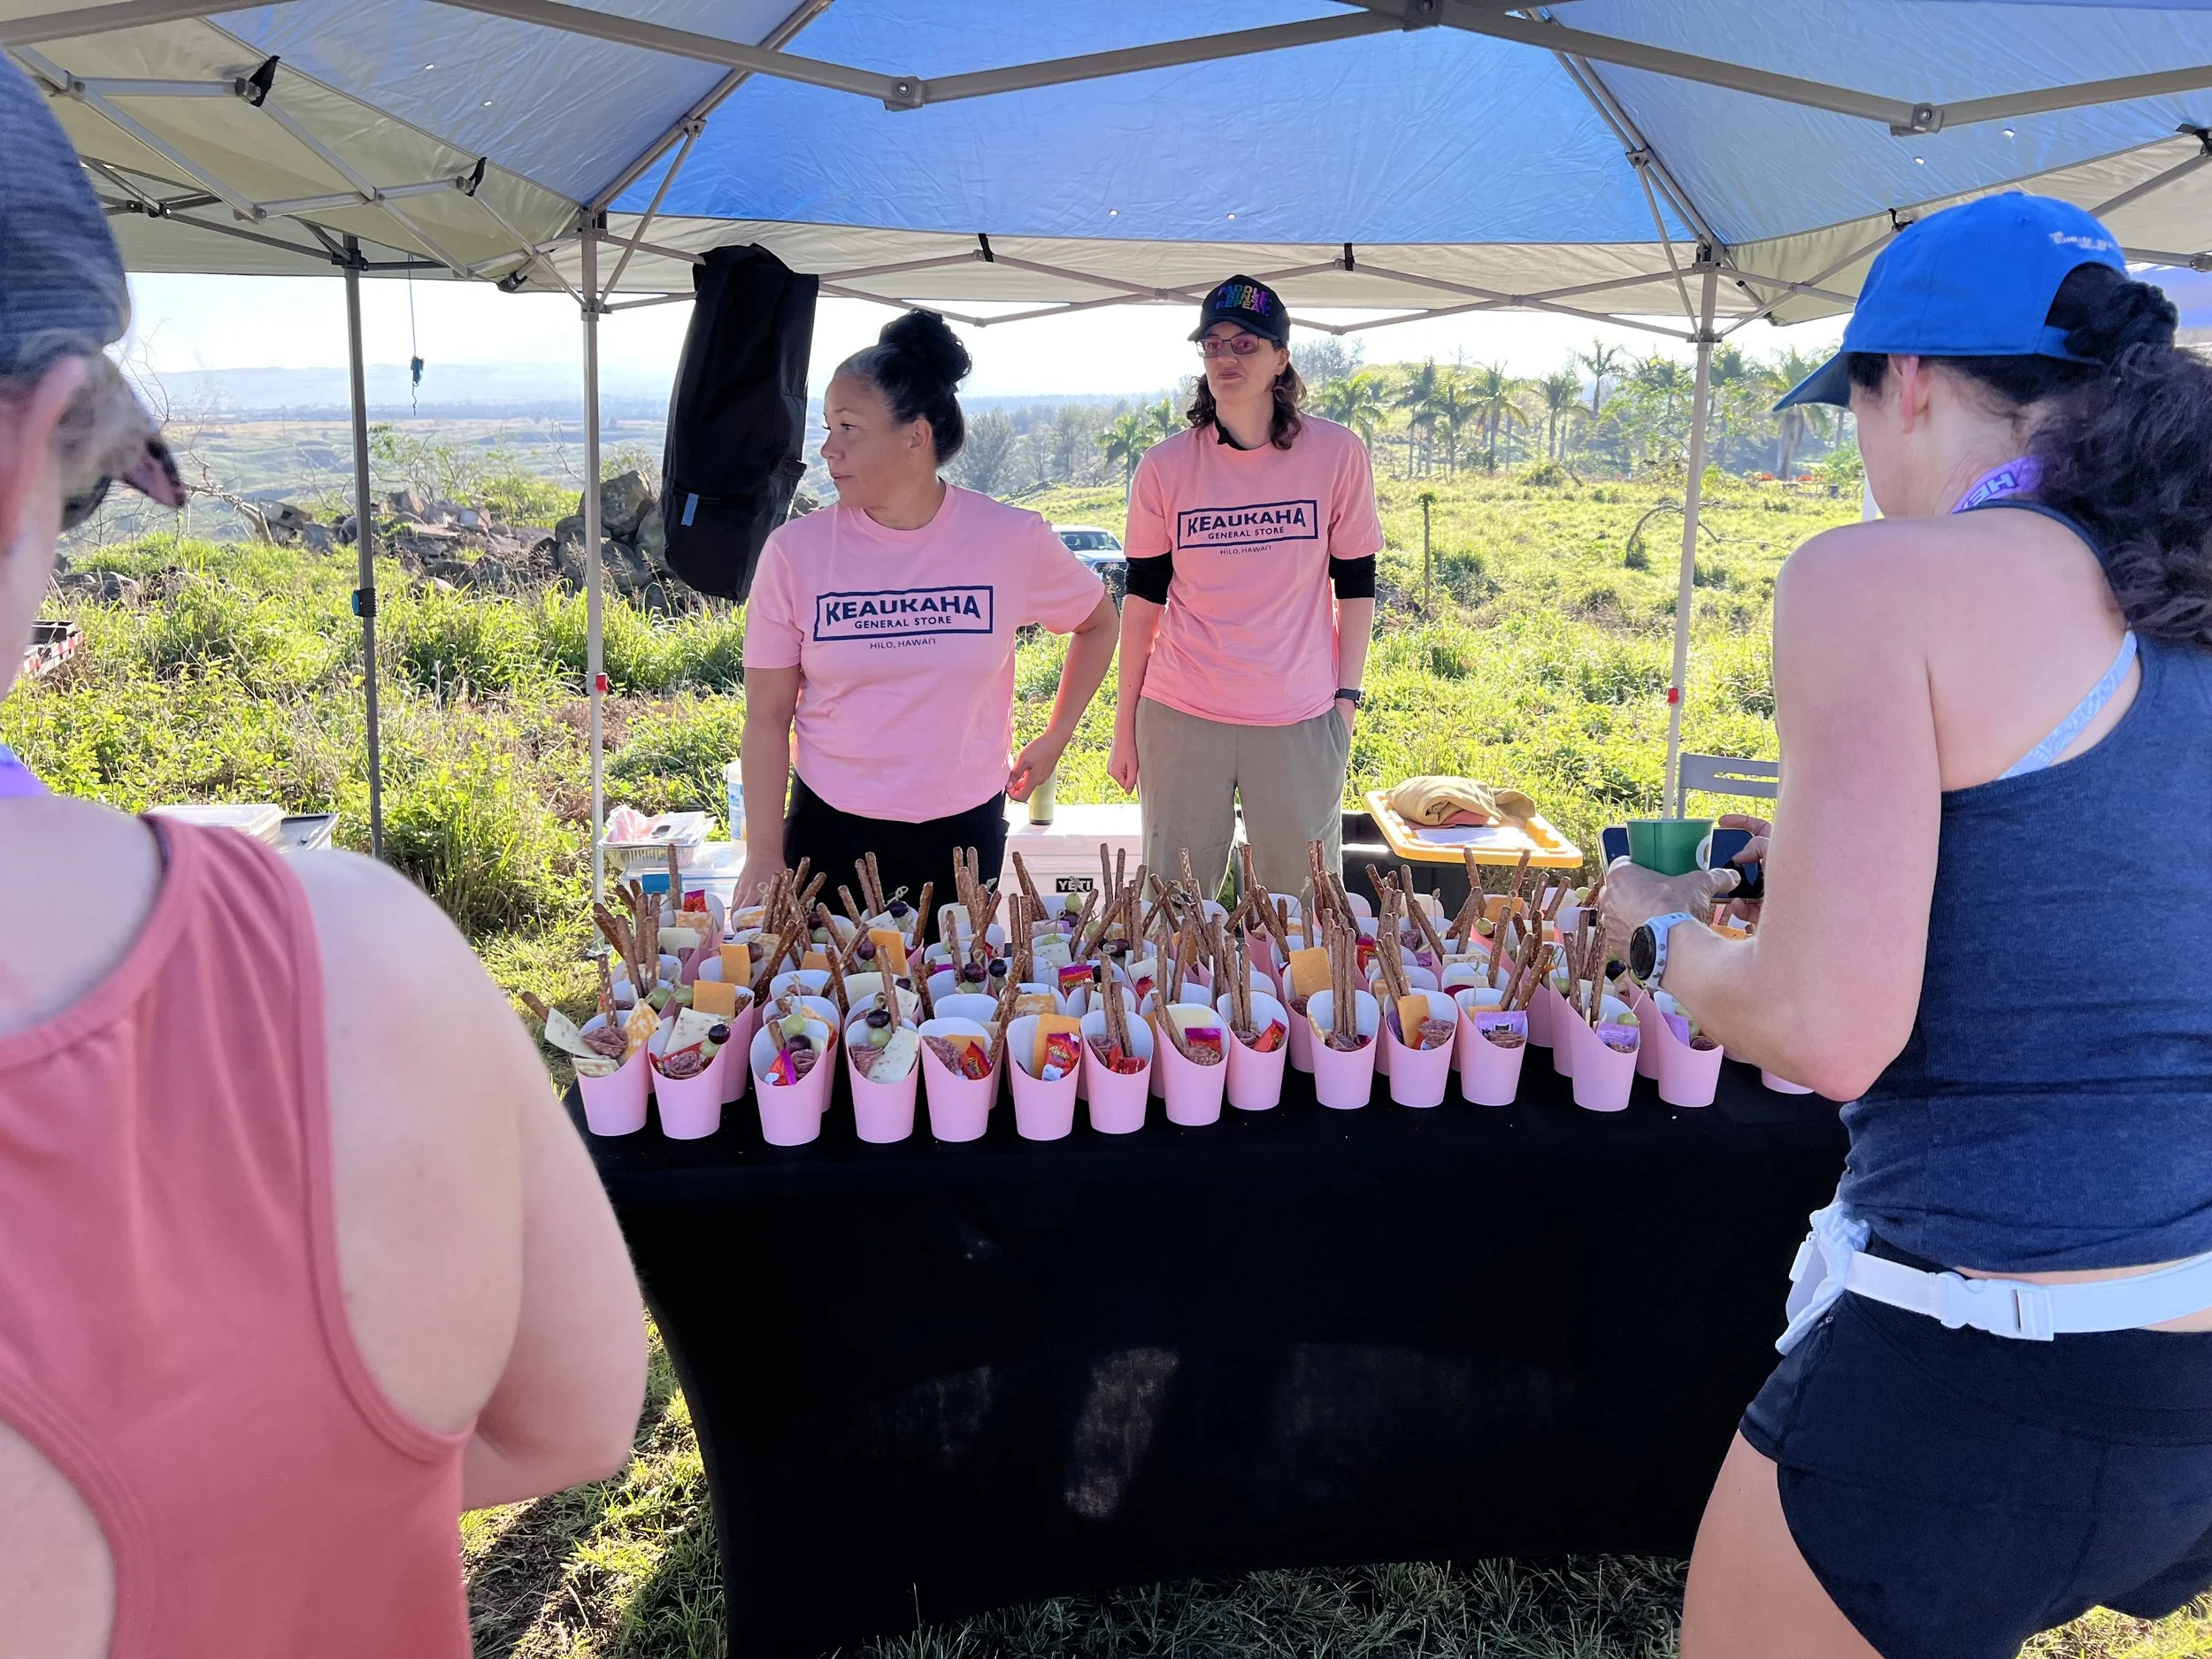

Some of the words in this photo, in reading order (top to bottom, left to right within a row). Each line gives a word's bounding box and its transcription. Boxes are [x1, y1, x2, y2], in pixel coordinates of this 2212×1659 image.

[1187, 507, 1307, 538] KEAUKAHA
[1209, 529, 1251, 540] GENERAL
[1255, 526, 1285, 536] STORE
[1220, 548, 1241, 557] HILO,
[826, 595, 981, 626] KEAUKAHA
[854, 618, 910, 629] GENERAL
[914, 615, 952, 626] STORE
[870, 641, 896, 649] HILO,
[1057, 879, 1092, 891] YETI
